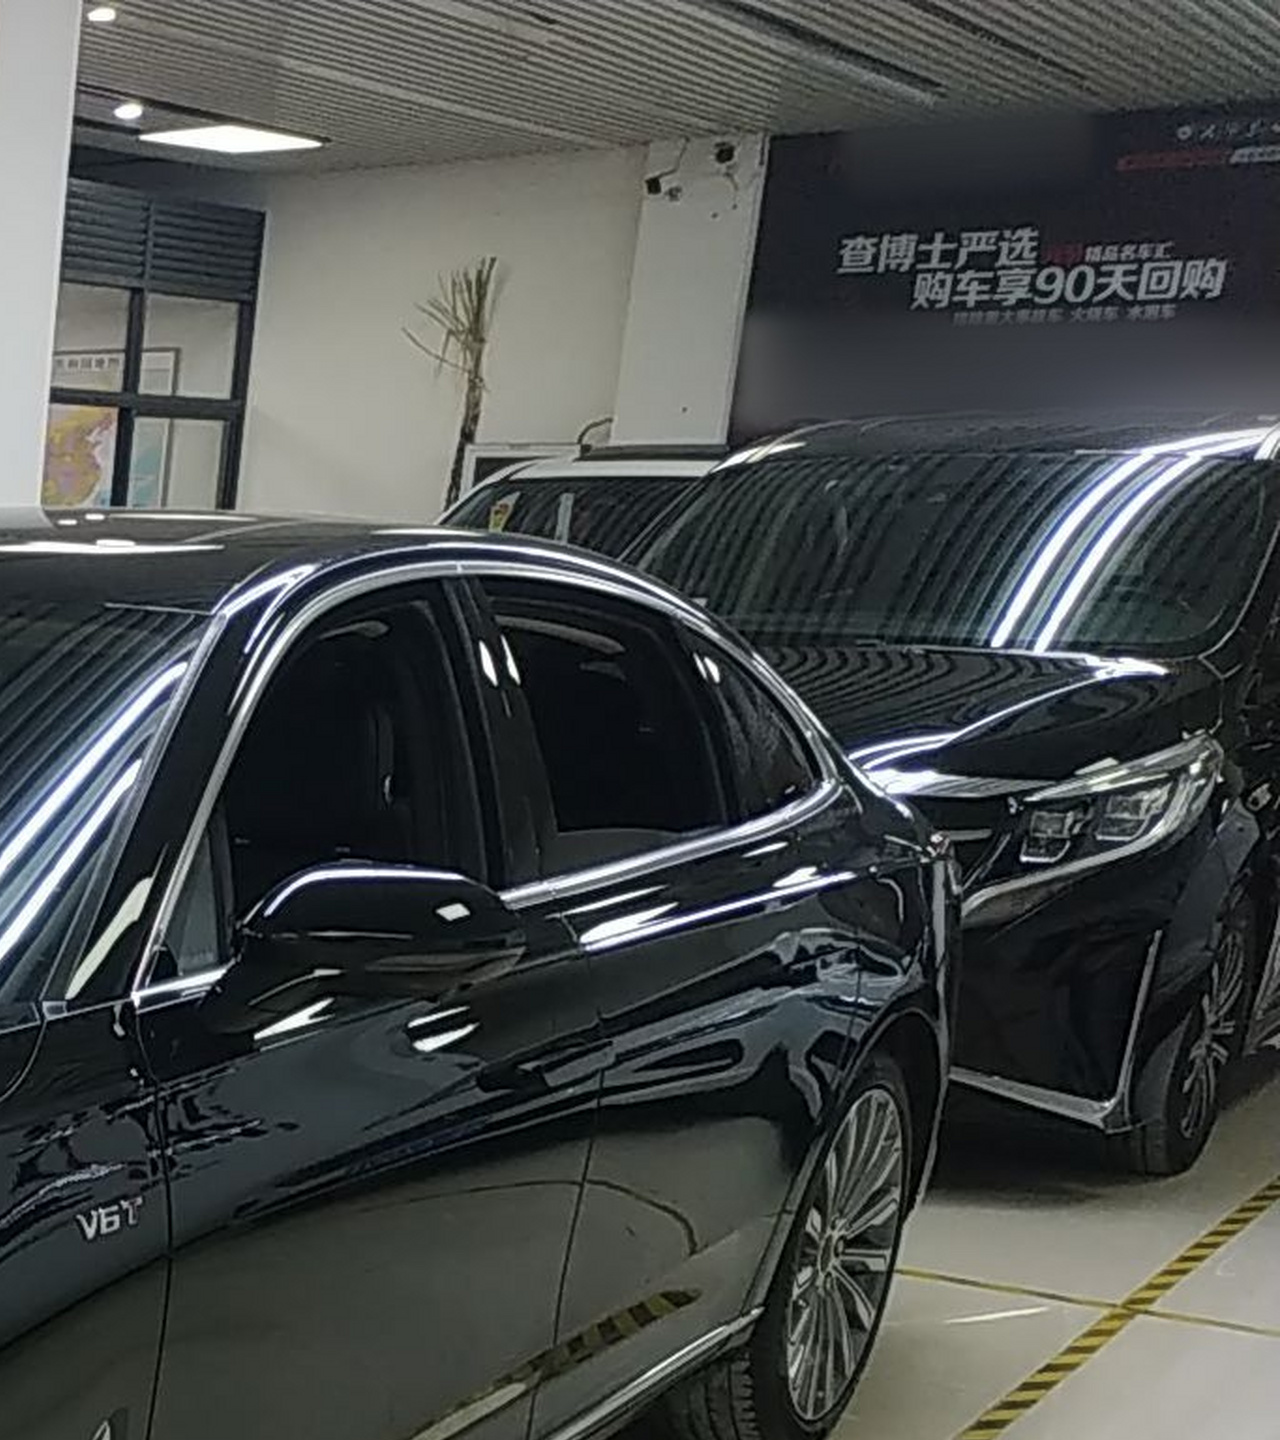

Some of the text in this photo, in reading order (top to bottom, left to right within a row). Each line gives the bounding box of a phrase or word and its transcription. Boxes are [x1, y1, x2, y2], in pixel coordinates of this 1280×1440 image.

[836, 226, 1040, 274] 查博士严选
[1085, 241, 1176, 263] 精品名车汇
[911, 258, 1228, 310] 购车享90天回购
[75, 1196, 144, 1240] V6T
